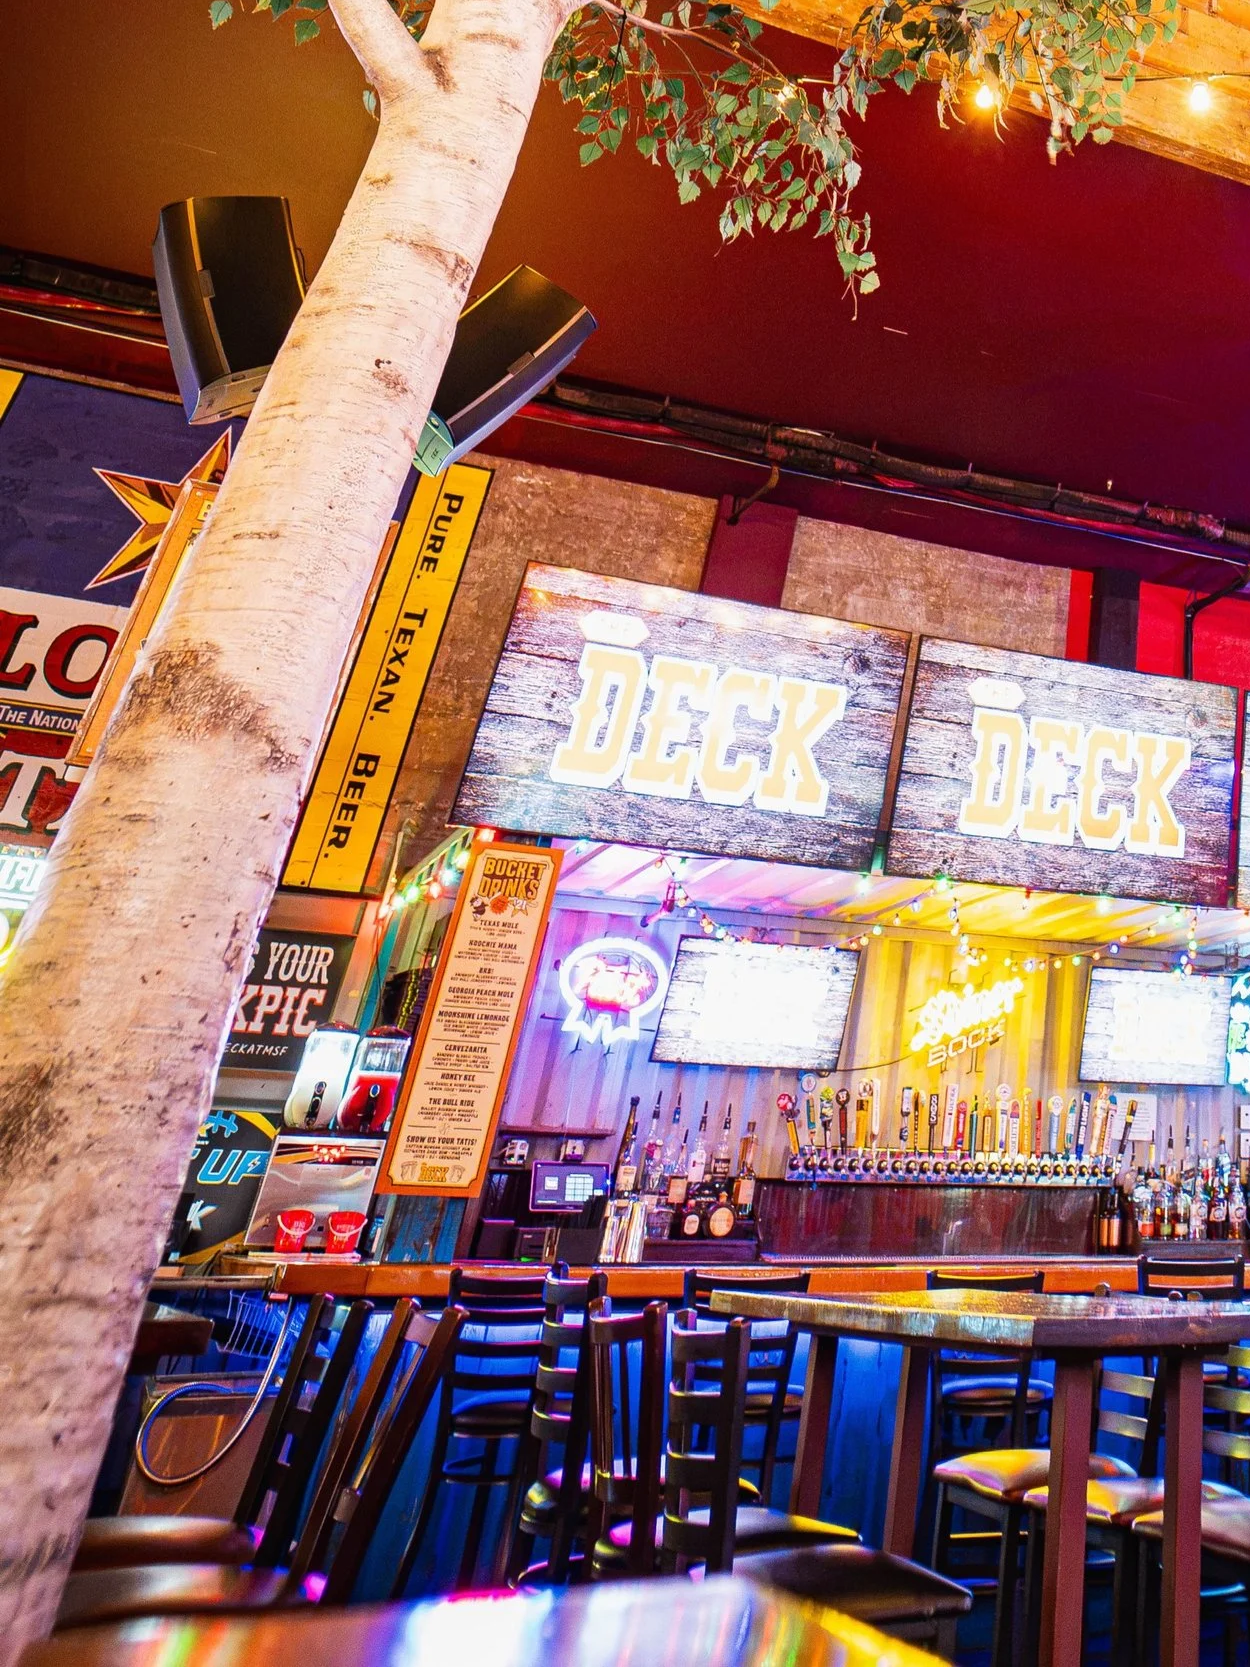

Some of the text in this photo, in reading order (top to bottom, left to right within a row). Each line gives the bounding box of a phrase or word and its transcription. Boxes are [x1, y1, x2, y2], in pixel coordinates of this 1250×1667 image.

[323, 492, 464, 859] PURE. TEXAN. BEER.
[551, 645, 847, 816] DECK
[959, 706, 1191, 858] DECK
[483, 857, 547, 880] BUCKET
[478, 876, 540, 900] DRINKS
[498, 942, 517, 950] MAMA
[264, 941, 334, 985] YOUR
[448, 986, 474, 994] GEORGIA
[438, 1010, 510, 1022] MOONSHINE LEMONADE
[445, 1044, 487, 1053] CERVEZARITA
[927, 1019, 1006, 1067] BOCK
[464, 1074, 475, 1082] BEE
[1078, 1101, 1090, 1146] BUD LIGHT
[406, 1135, 426, 1143] SHOW
[427, 1136, 437, 1144] US
[438, 1137, 456, 1145] YOUR
[197, 1148, 270, 1185] UP
